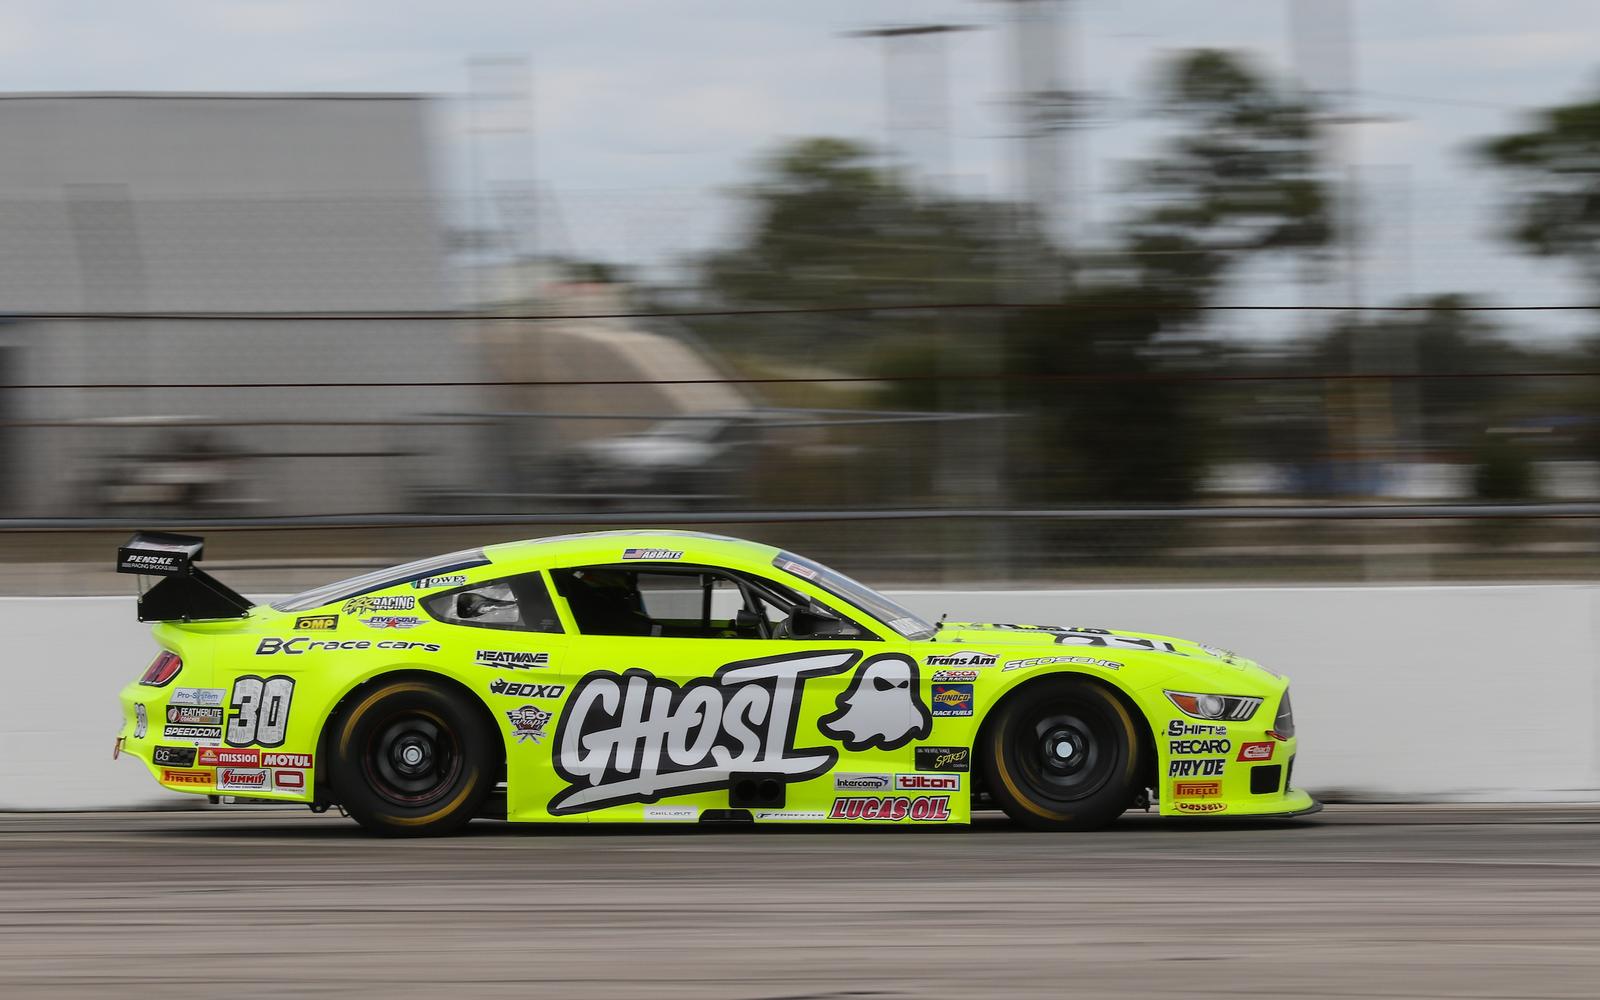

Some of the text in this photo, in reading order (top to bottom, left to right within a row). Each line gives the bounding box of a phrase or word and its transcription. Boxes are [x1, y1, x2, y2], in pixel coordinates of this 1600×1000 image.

[127, 555, 174, 565] PENSKE
[641, 551, 683, 559] ABBATE
[373, 596, 414, 610] RACING
[299, 617, 334, 630] OMP
[255, 637, 441, 655] BC race cars
[476, 651, 549, 663] HEATWAVE
[926, 655, 997, 665] Trans Am
[1002, 656, 1122, 672] SCOSCHE
[177, 691, 218, 700] Pro-System
[504, 682, 566, 698] BOXO
[935, 693, 969, 701] SUNOCO
[180, 707, 223, 717] FEATHERLITE
[224, 675, 296, 748] 30
[552, 650, 860, 812] GHOST
[1168, 720, 1215, 736] SHIFT
[1170, 739, 1231, 754] RECARO
[155, 750, 169, 761] CG
[263, 754, 311, 767] MOTUL
[934, 750, 968, 769] SPIKED
[1169, 759, 1226, 776] PRYDE
[164, 770, 212, 784] PIRELLI
[837, 778, 882, 788] Intercomp
[899, 776, 956, 789] tilton
[1177, 783, 1219, 795] PIRELLI
[828, 795, 950, 821] LUCAS OIL
